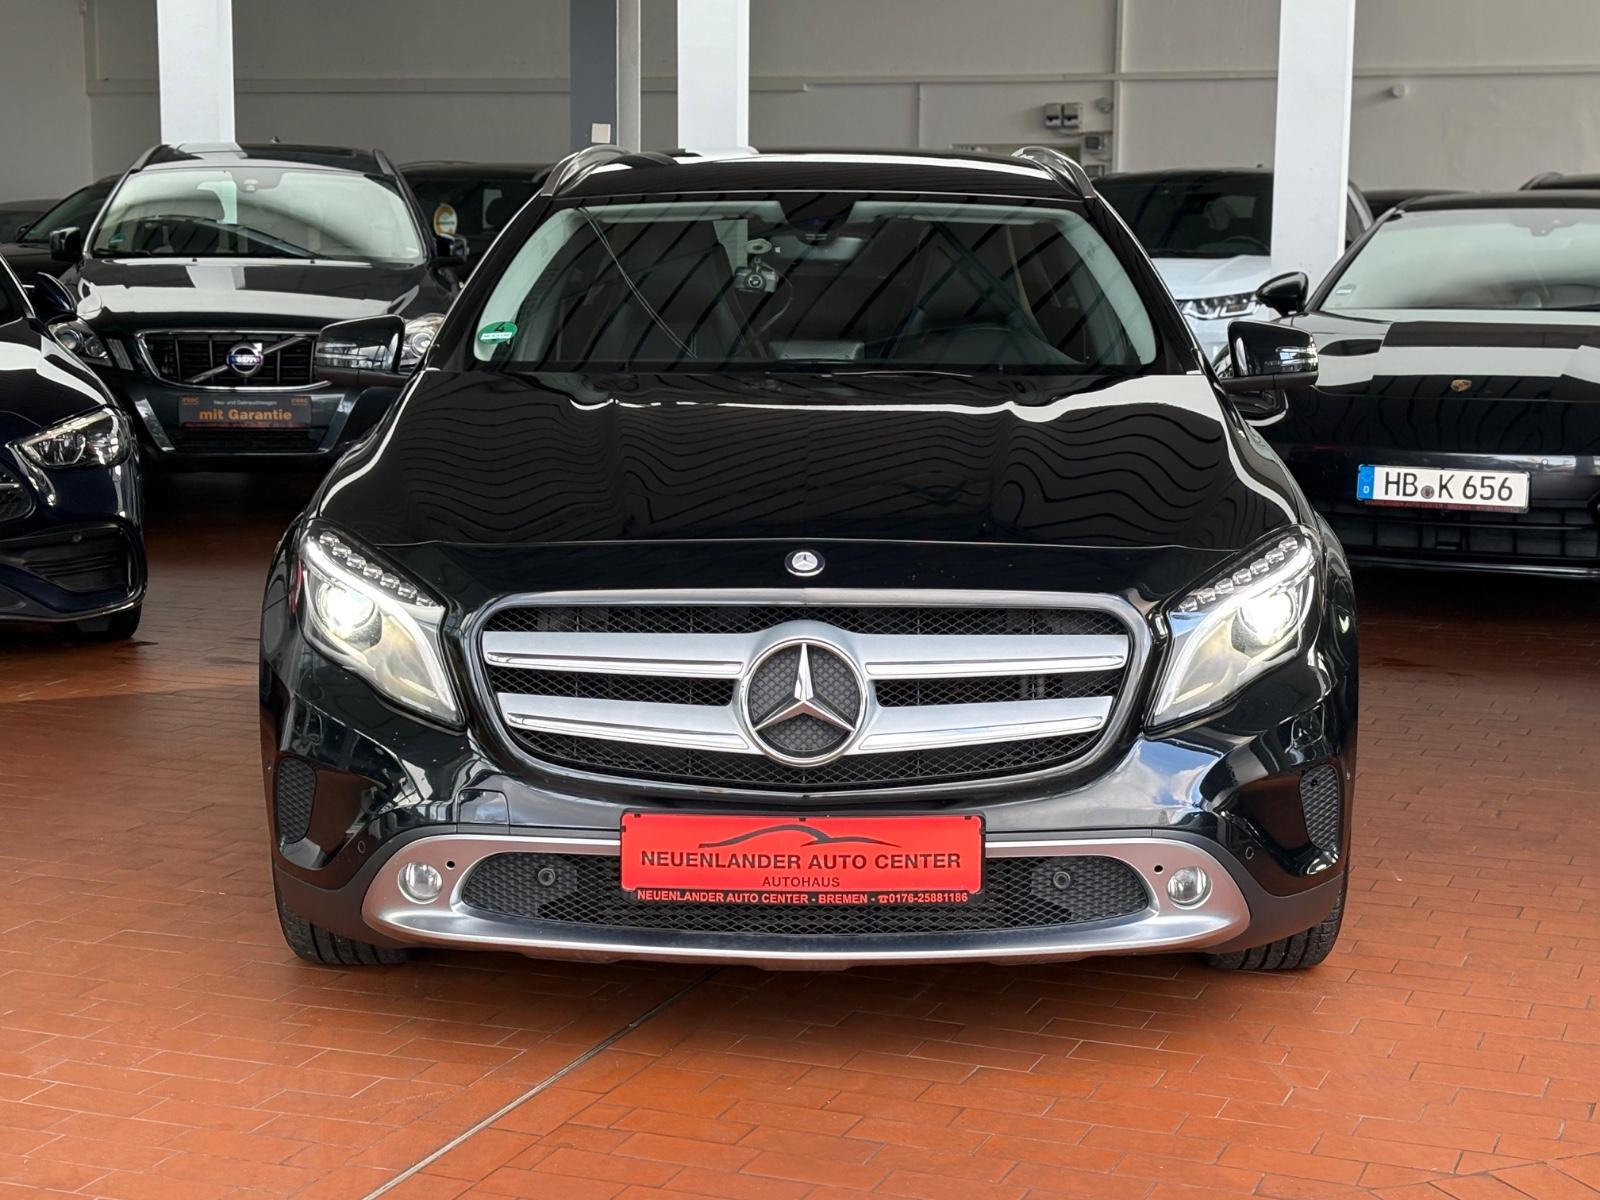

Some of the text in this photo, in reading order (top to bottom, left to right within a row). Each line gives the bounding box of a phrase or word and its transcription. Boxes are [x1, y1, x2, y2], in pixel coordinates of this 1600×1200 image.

[199, 408, 293, 420] mit Garantie
[1362, 485, 1370, 494] D
[1384, 471, 1513, 502] HB K 656
[641, 850, 961, 869] NEUENLANDER AUTO CENTER
[762, 876, 840, 888] AUTOHAUS
[637, 889, 725, 902] NEUENLANDER
[726, 893, 758, 904] AUTO
[761, 893, 808, 905] CENTER
[818, 893, 868, 904] BREMEN
